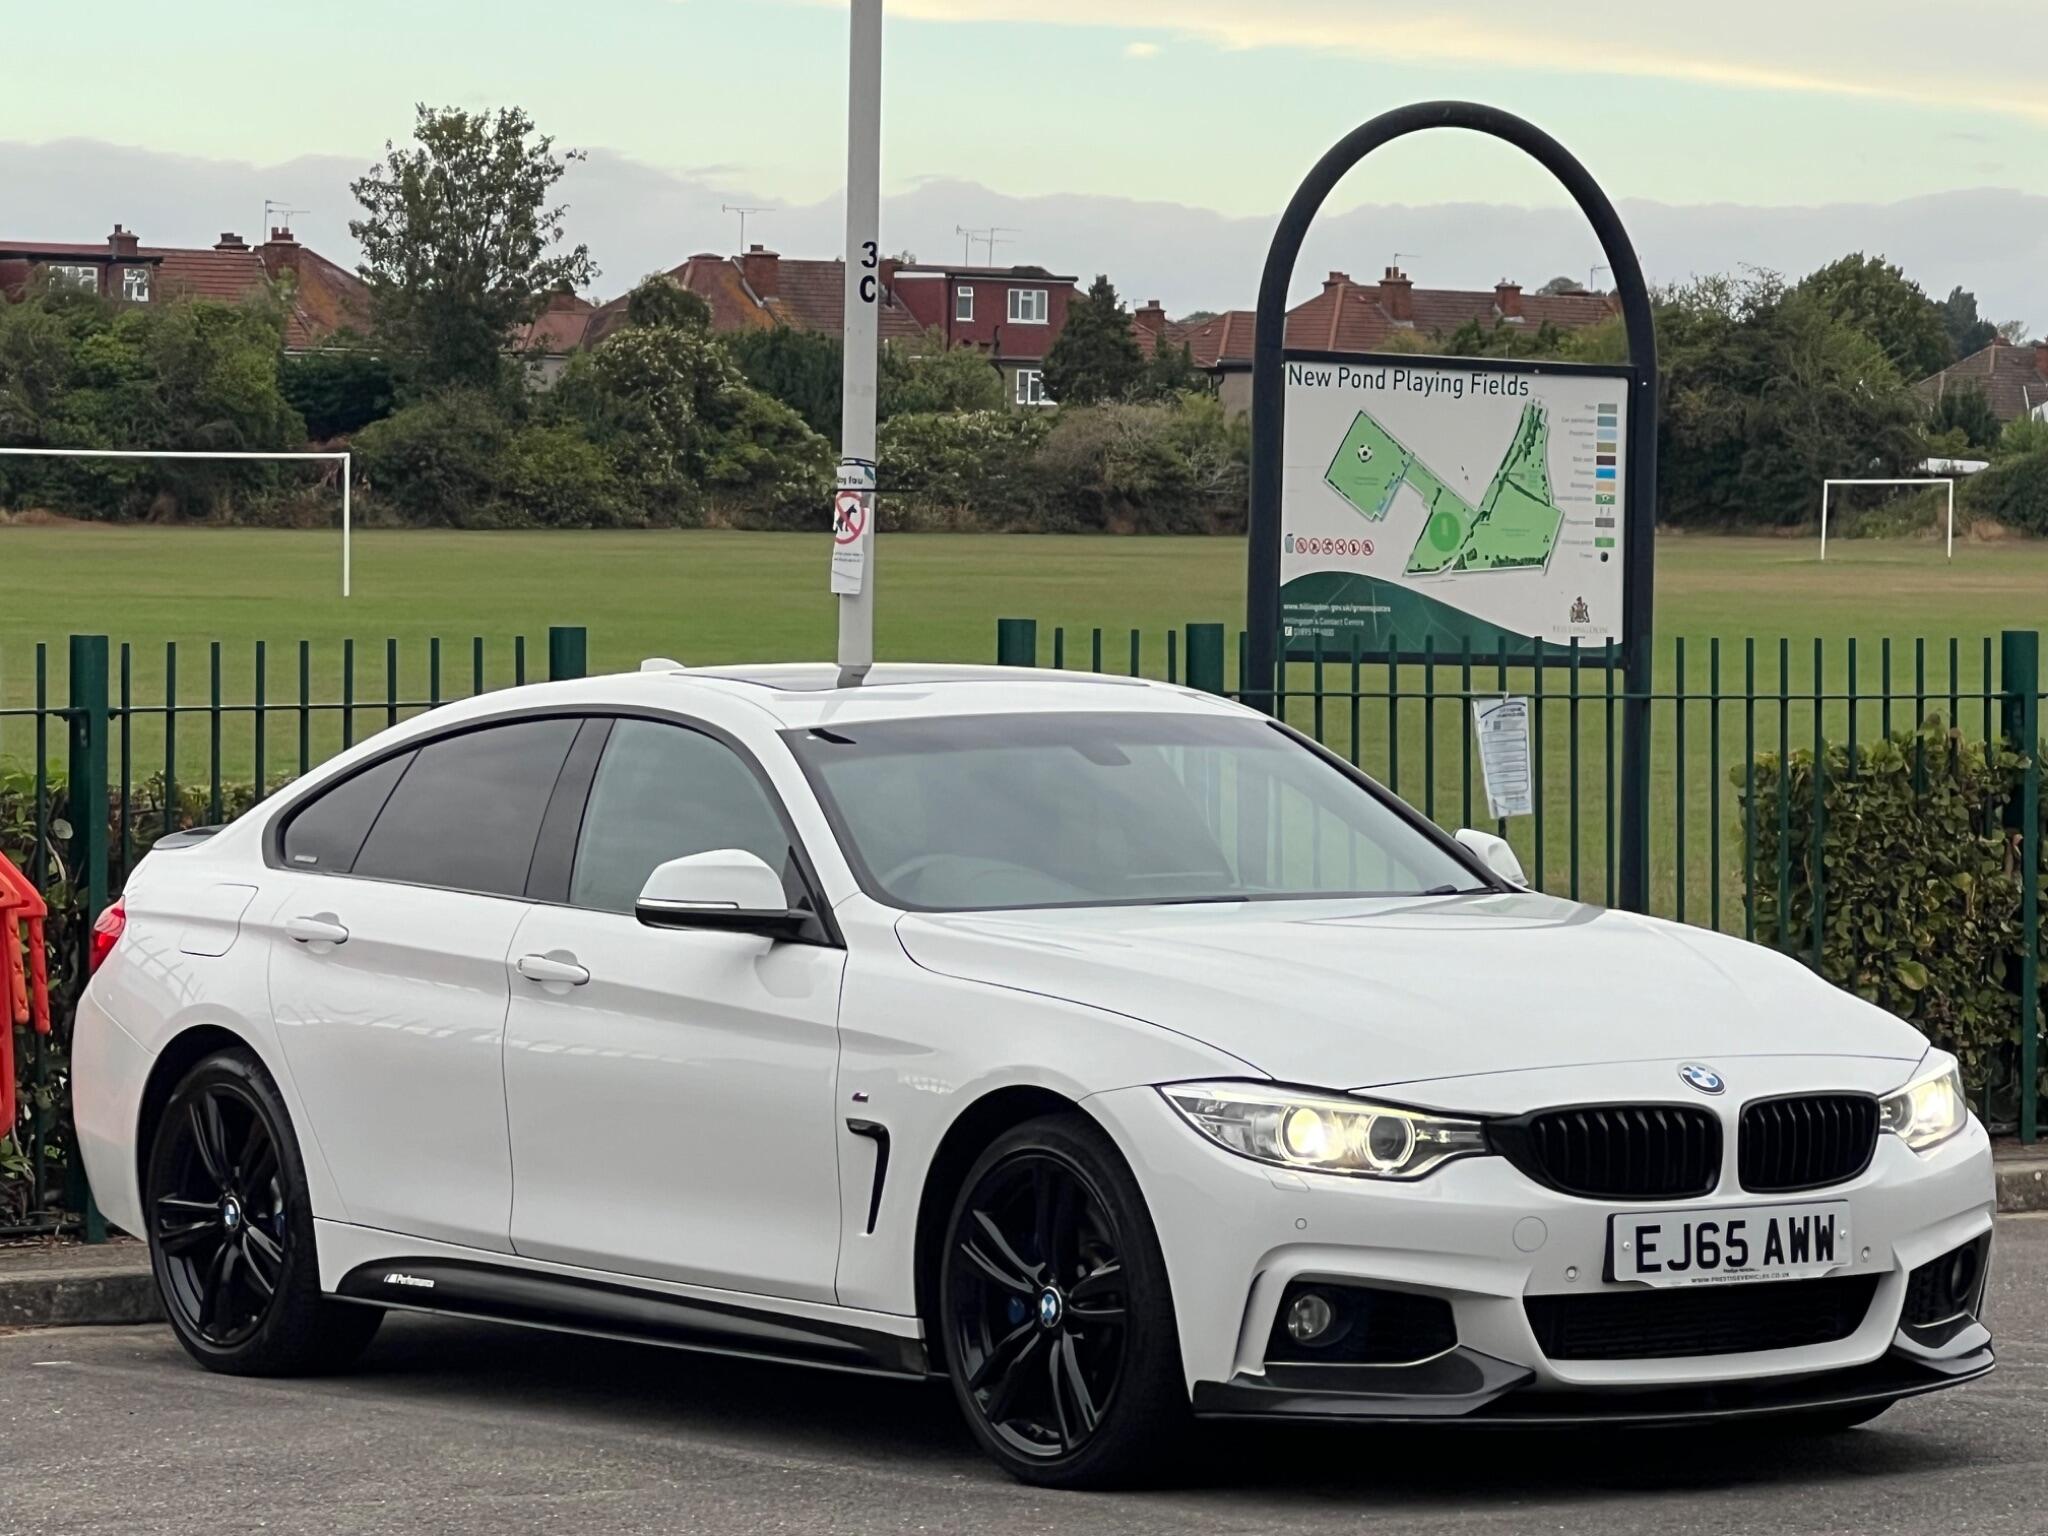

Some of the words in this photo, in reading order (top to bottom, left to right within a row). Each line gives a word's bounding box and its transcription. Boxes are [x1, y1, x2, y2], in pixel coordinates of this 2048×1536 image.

[861, 241, 877, 268] 3
[859, 275, 876, 303] C
[1288, 364, 1331, 387] New
[1338, 367, 1385, 390] Pond
[1393, 370, 1463, 398] Playing
[1471, 373, 1528, 396] Fields
[1636, 1220, 1748, 1273] EJ65
[1763, 1214, 1835, 1265] AWW
